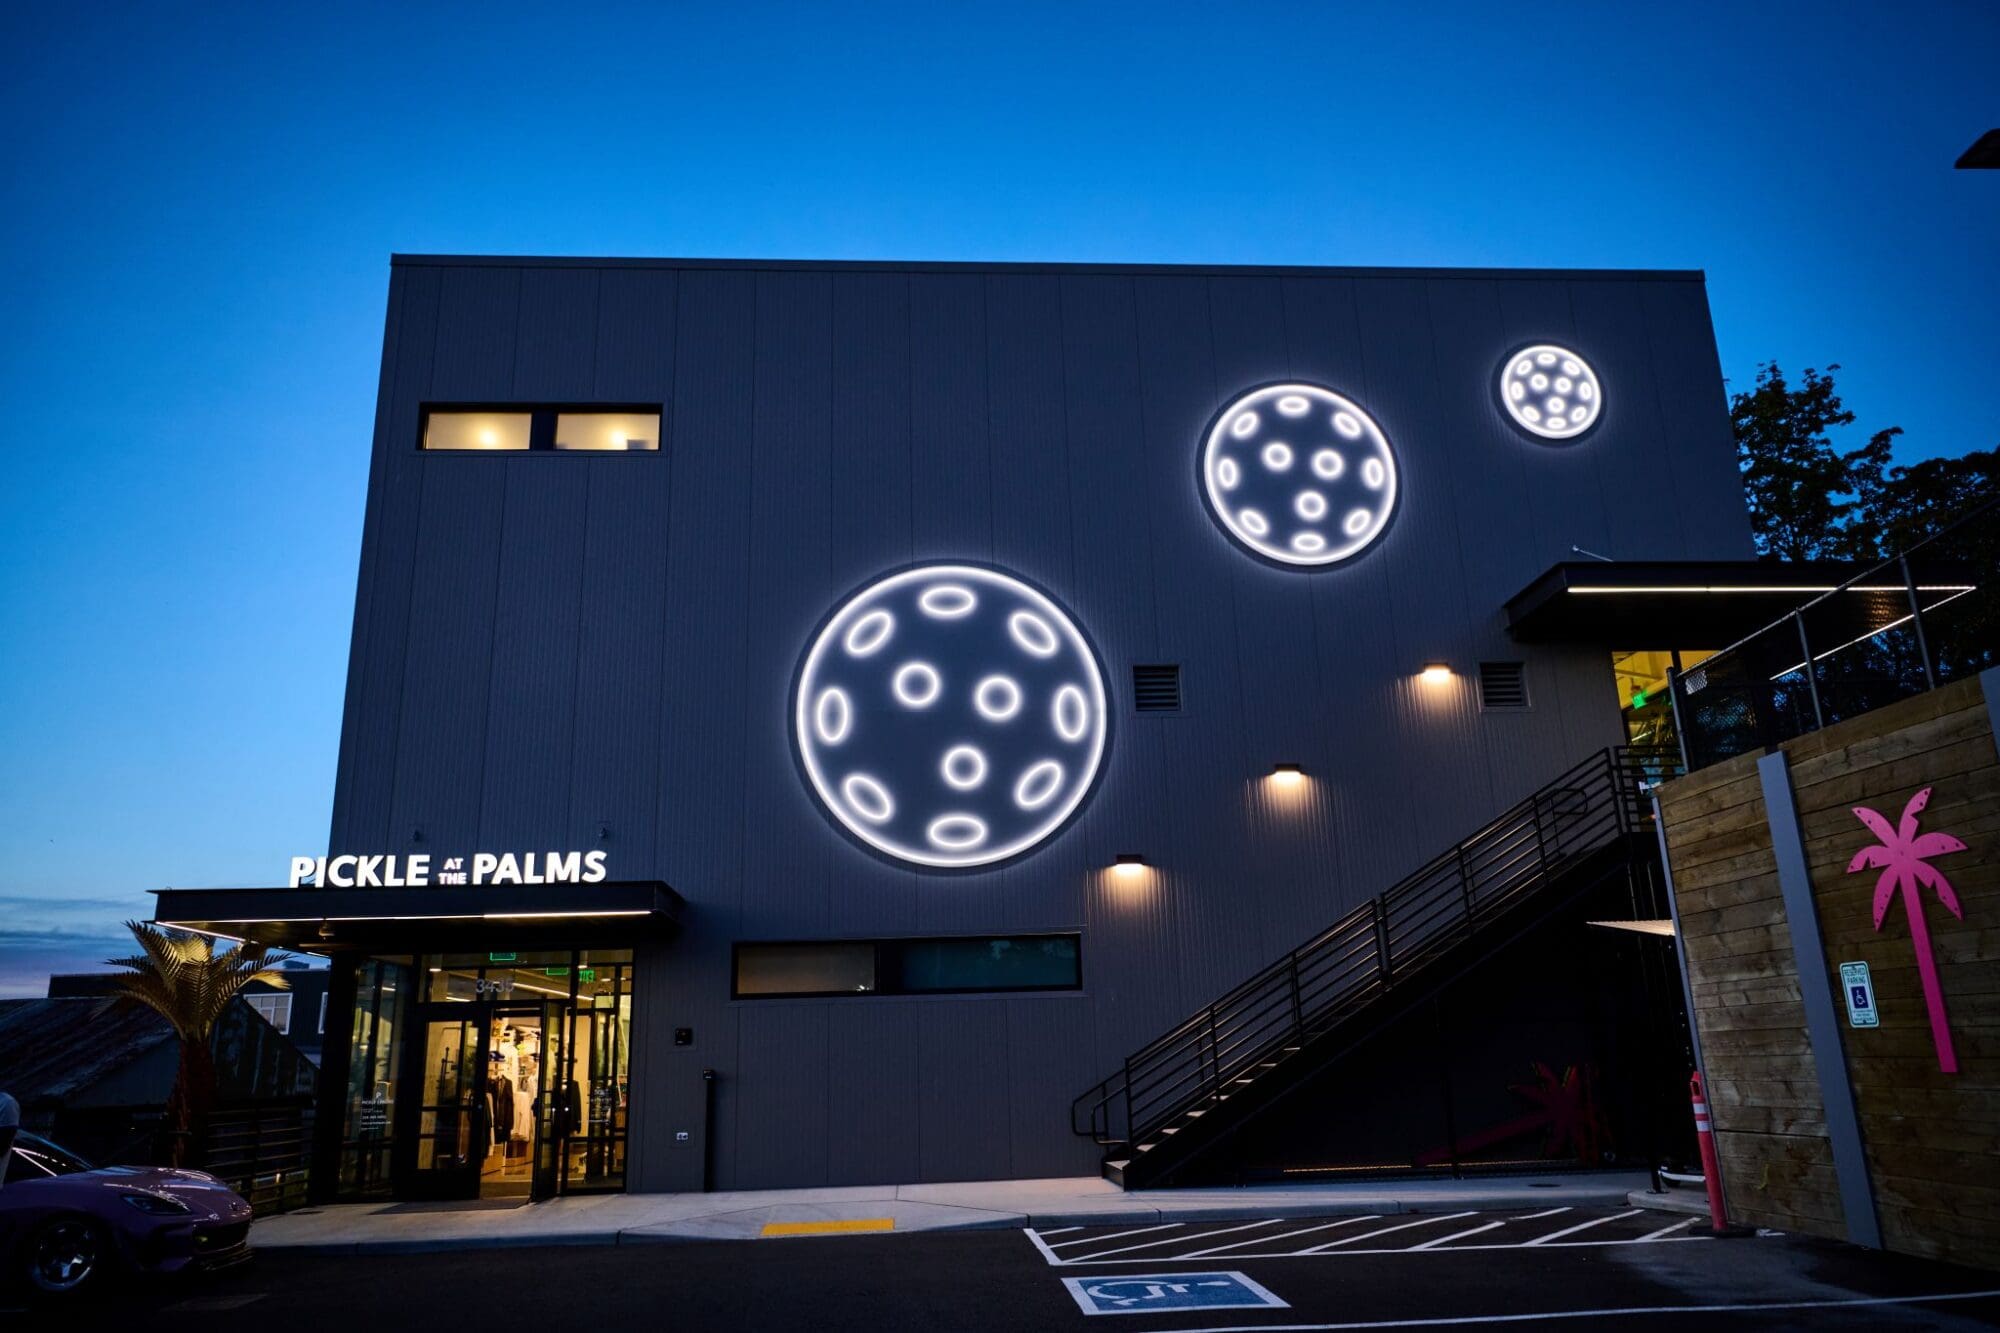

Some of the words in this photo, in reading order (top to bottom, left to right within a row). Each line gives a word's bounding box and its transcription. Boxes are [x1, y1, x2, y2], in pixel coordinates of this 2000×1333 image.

[443, 857, 464, 870] AT
[472, 850, 607, 885] PALMS
[290, 855, 430, 888] PICKLE
[438, 872, 466, 885] THE
[475, 978, 515, 993] 3435
